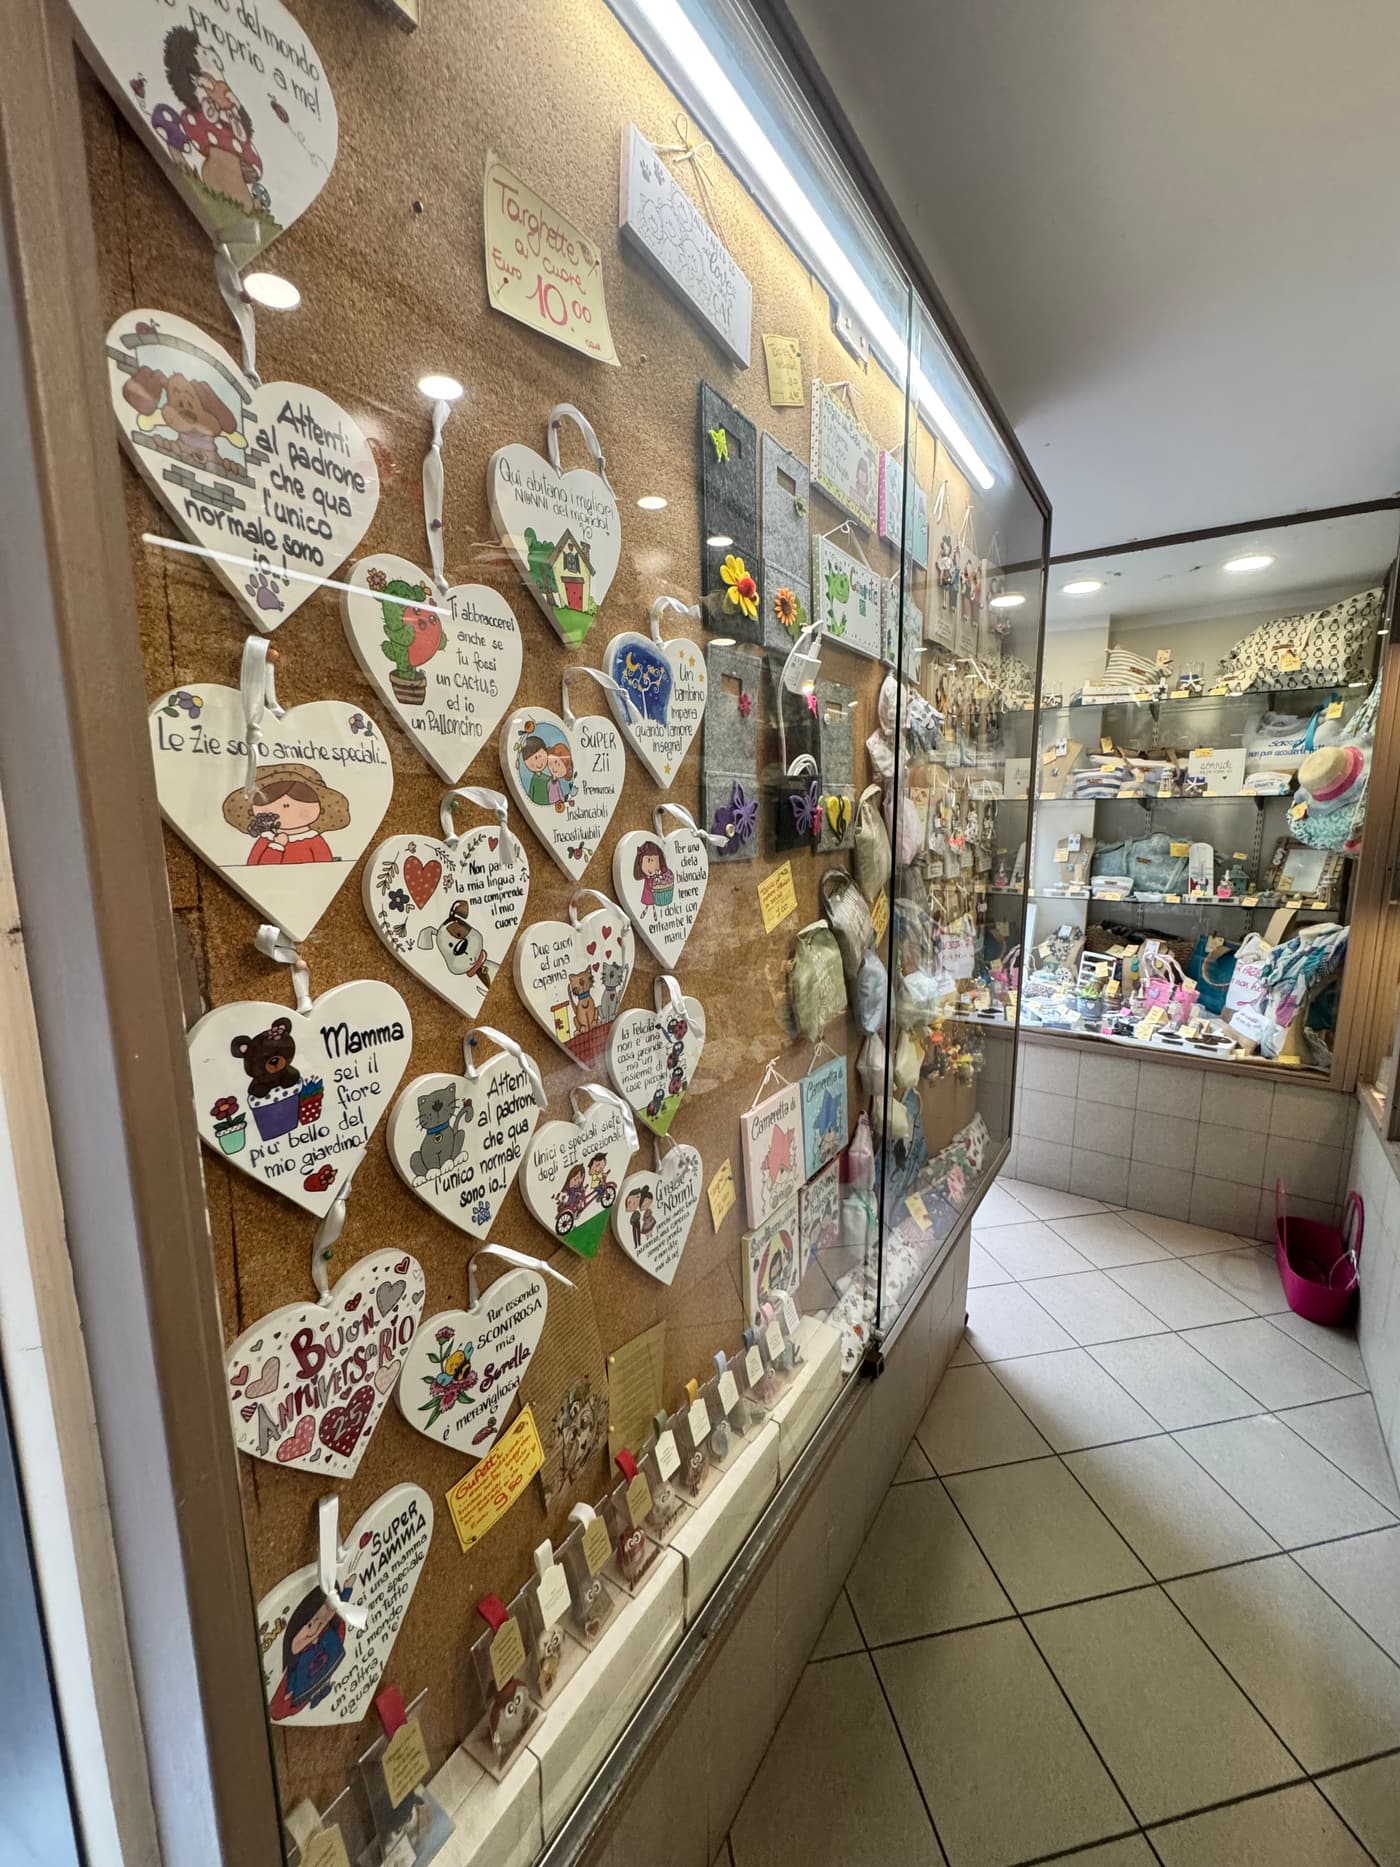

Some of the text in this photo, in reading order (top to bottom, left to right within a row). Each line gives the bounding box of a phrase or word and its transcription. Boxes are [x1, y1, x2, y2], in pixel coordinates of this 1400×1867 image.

[189, 5, 322, 123] proprio a me!
[263, 25, 320, 82] mondo
[492, 178, 579, 266] Targhette
[492, 247, 522, 280] Euro
[515, 238, 586, 295] a cuore
[277, 401, 351, 457] Attenti
[256, 425, 365, 493] al padrone
[270, 464, 352, 517] che qua
[500, 457, 522, 483] Qui
[527, 471, 568, 503] abitano
[264, 487, 333, 540] l'unico
[553, 501, 569, 518] del
[184, 498, 324, 567] normale sono
[447, 595, 515, 632] Ti abbraccerei
[457, 631, 504, 650] anche se
[457, 649, 497, 672] tu fossi
[679, 664, 694, 681] Un
[436, 675, 451, 686] un
[447, 694, 475, 713] ed io
[674, 685, 704, 702] bambino
[411, 717, 426, 730] un
[635, 725, 664, 742] quando
[158, 717, 184, 752] Le
[190, 725, 221, 754] Zie
[227, 740, 269, 755] soo
[273, 740, 329, 760] amiche
[582, 781, 615, 795] Premurosi
[567, 806, 608, 822] Instancabili
[553, 825, 601, 843] Insostituibili
[674, 840, 699, 854] Per una
[469, 861, 485, 876] Non
[681, 857, 698, 866] dieta
[455, 873, 515, 893] la mia lingua
[678, 888, 699, 899] tenere
[470, 887, 524, 905] ma comprende
[491, 903, 514, 916] il mio
[665, 903, 682, 917] dolci
[686, 902, 698, 912] con
[495, 917, 518, 929] cuore
[649, 915, 692, 934] entrambe le
[531, 937, 573, 959] Due cuori
[541, 954, 570, 971] ed una
[533, 969, 568, 991] capanna
[320, 1021, 404, 1059] Mamma
[617, 1042, 633, 1053] non
[645, 1032, 660, 1043] una
[617, 1042, 663, 1064] cosa grande
[627, 1056, 653, 1071] ma un
[333, 1052, 379, 1083] sei il
[622, 1060, 662, 1084] insieme di
[337, 1081, 382, 1110] fiore
[487, 1070, 529, 1099] Attent
[626, 1082, 642, 1093] cose
[477, 1102, 492, 1127] al
[751, 1100, 789, 1141] Cameretta
[288, 1124, 330, 1148] bello
[339, 1107, 364, 1131] del
[483, 1118, 529, 1150] che qua
[533, 1143, 556, 1168] Unici
[568, 1124, 598, 1151] speciali
[601, 1112, 621, 1133] siete
[264, 1158, 296, 1179] mio
[434, 1142, 521, 1195] l'unico normale
[538, 1162, 558, 1182] degli
[460, 1184, 485, 1208] sono
[505, 1284, 541, 1311] essendo
[476, 1298, 542, 1350] SCONTROSA
[495, 1334, 516, 1352] mia
[479, 1343, 531, 1393] Sorella
[333, 1403, 362, 1441] 25
[359, 1513, 425, 1587] MAMMA
[352, 1534, 427, 1606] ei una mamma
[387, 1551, 424, 1593] speciale
[371, 1610, 382, 1624] in
[382, 1583, 408, 1610] tutto
[354, 1642, 362, 1659] il
[367, 1605, 403, 1645] mondo
[333, 1664, 359, 1694] non
